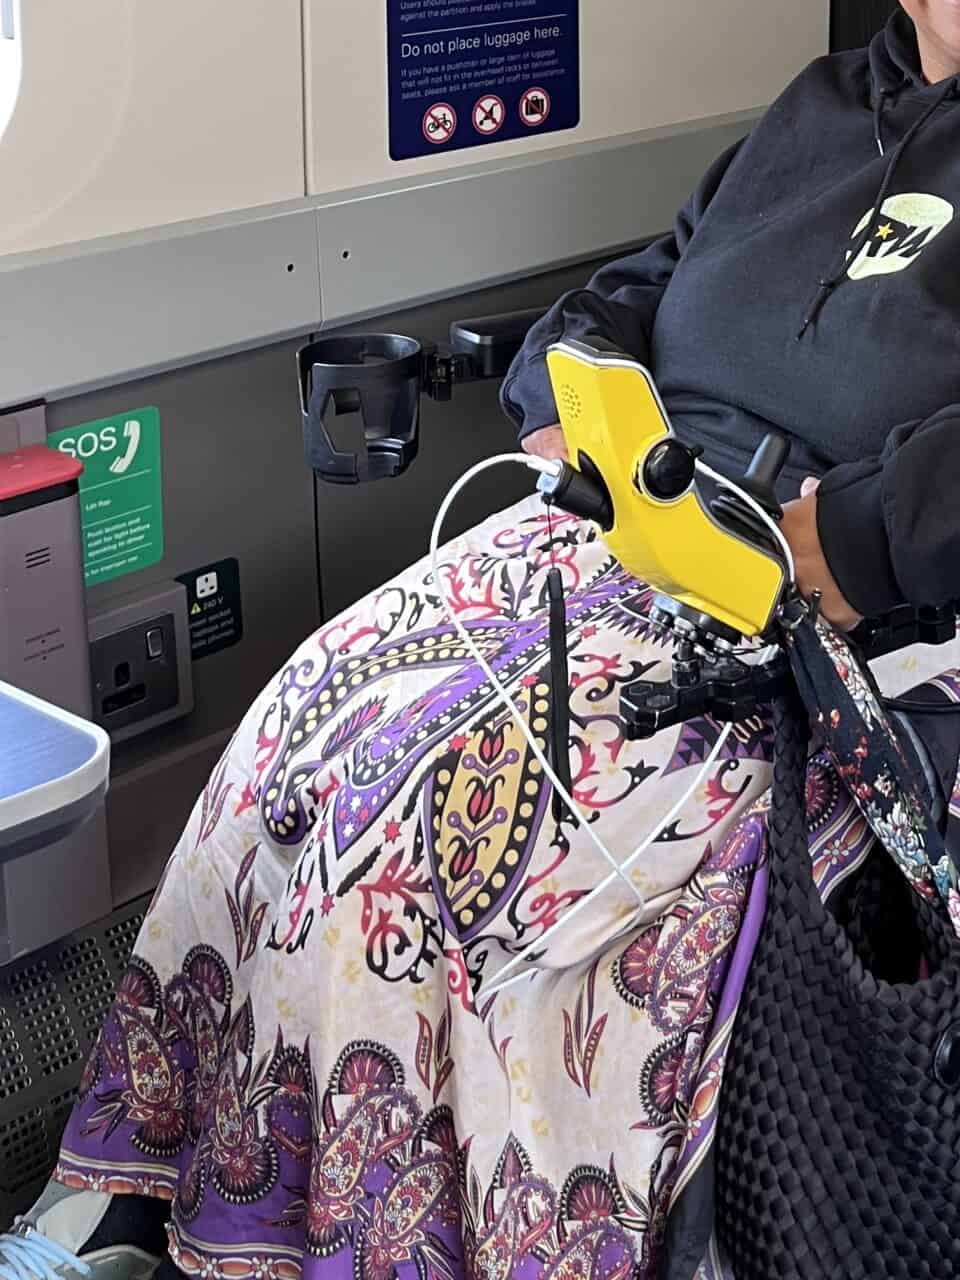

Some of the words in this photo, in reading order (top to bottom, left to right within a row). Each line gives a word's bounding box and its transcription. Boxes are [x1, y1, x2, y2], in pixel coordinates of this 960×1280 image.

[401, 43, 420, 58] Do
[424, 41, 444, 55] not
[448, 37, 481, 54] place
[484, 31, 531, 47] luggage
[58, 425, 117, 459] SOS
